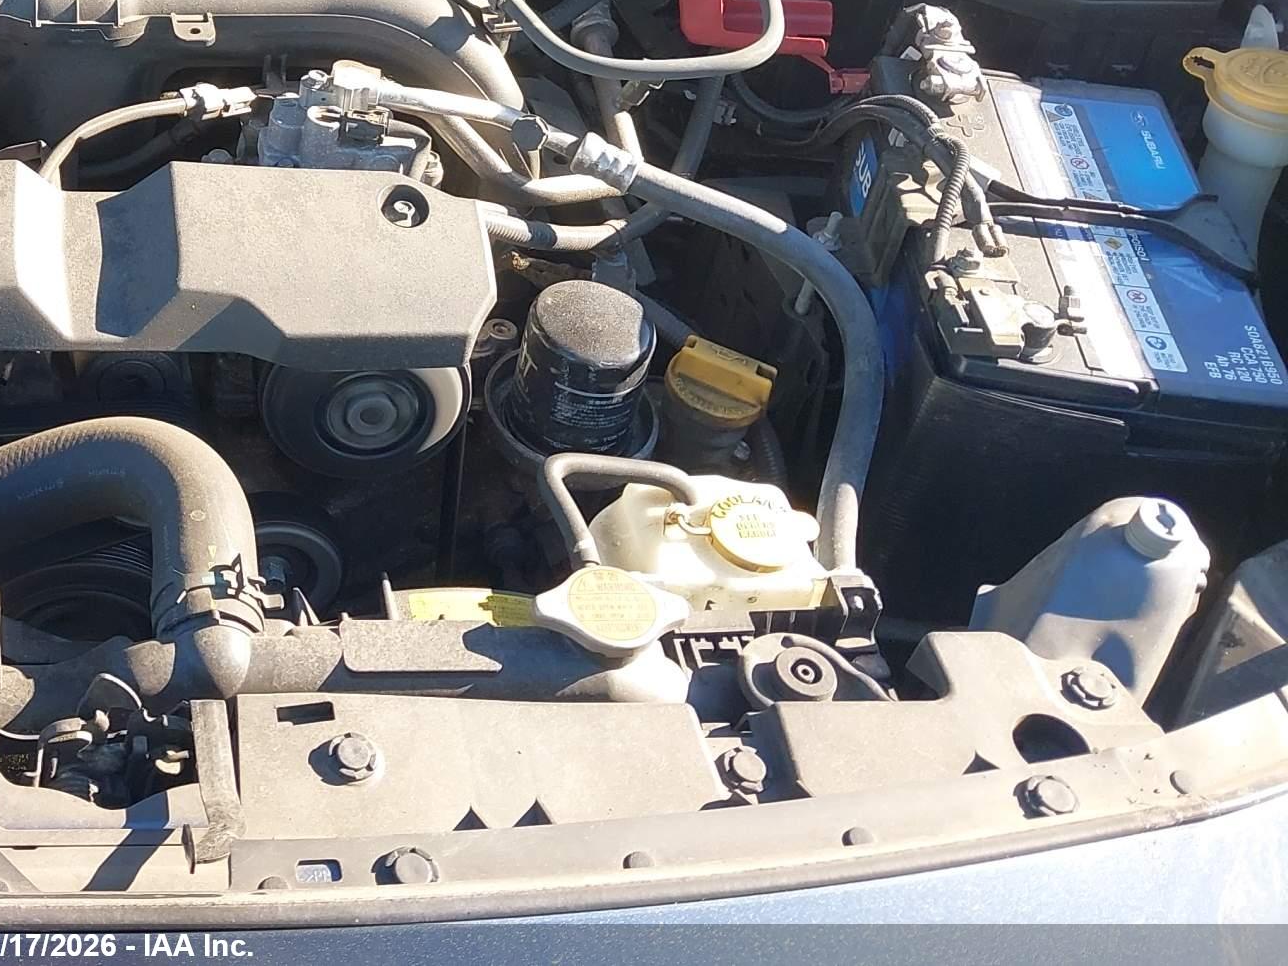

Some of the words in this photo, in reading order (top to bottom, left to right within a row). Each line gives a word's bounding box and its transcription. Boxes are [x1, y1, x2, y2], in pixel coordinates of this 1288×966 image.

[1141, 129, 1167, 169] SUBARU
[1131, 233, 1151, 262] POISO
[1227, 351, 1244, 365] RC
[1240, 346, 1259, 365] CCA
[1250, 366, 1268, 384] 750
[1203, 361, 1222, 379] EFB
[1222, 369, 1238, 381] 76
[1234, 367, 1253, 383] 120
